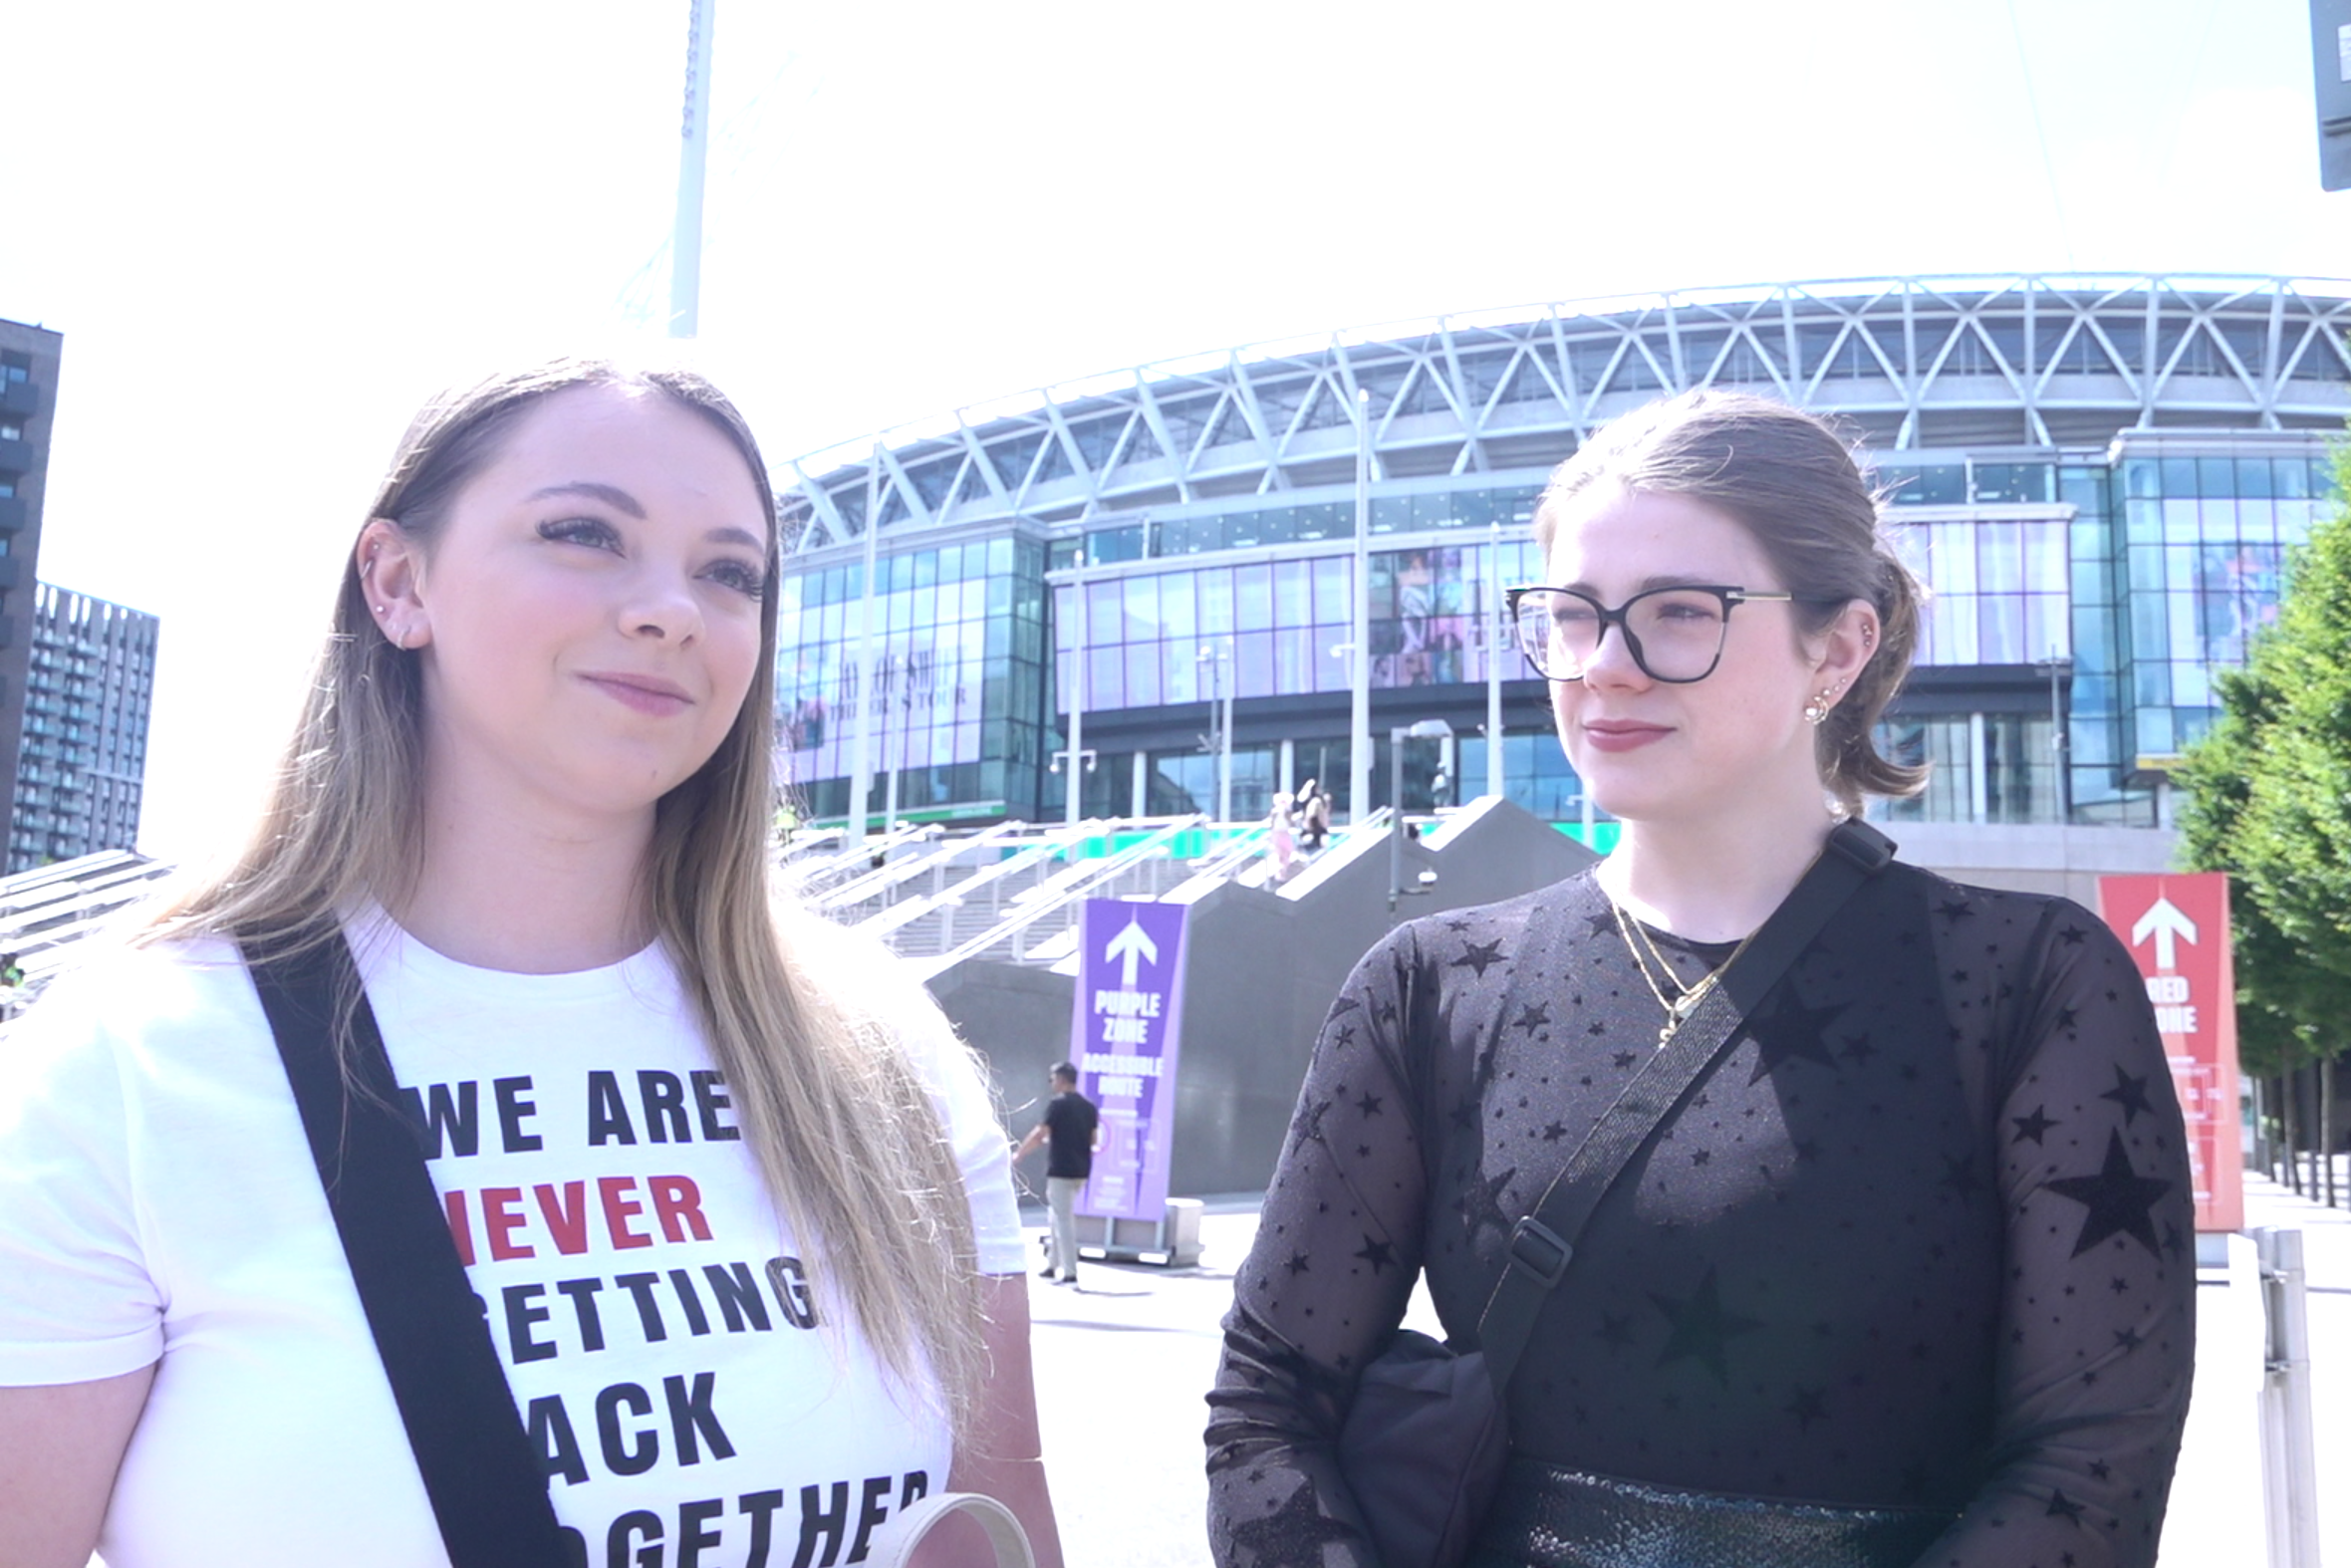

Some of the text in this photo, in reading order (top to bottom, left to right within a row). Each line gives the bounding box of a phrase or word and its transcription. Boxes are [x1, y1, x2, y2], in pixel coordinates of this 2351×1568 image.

[2145, 976, 2190, 1003] RED
[1095, 990, 1162, 1017] PURPLE
[1102, 1017, 1149, 1044] ZONE
[2155, 1006, 2199, 1033] ONE
[398, 1069, 742, 1161] WE ARE
[474, 1256, 819, 1365] ETTING
[527, 1372, 737, 1486] ACK
